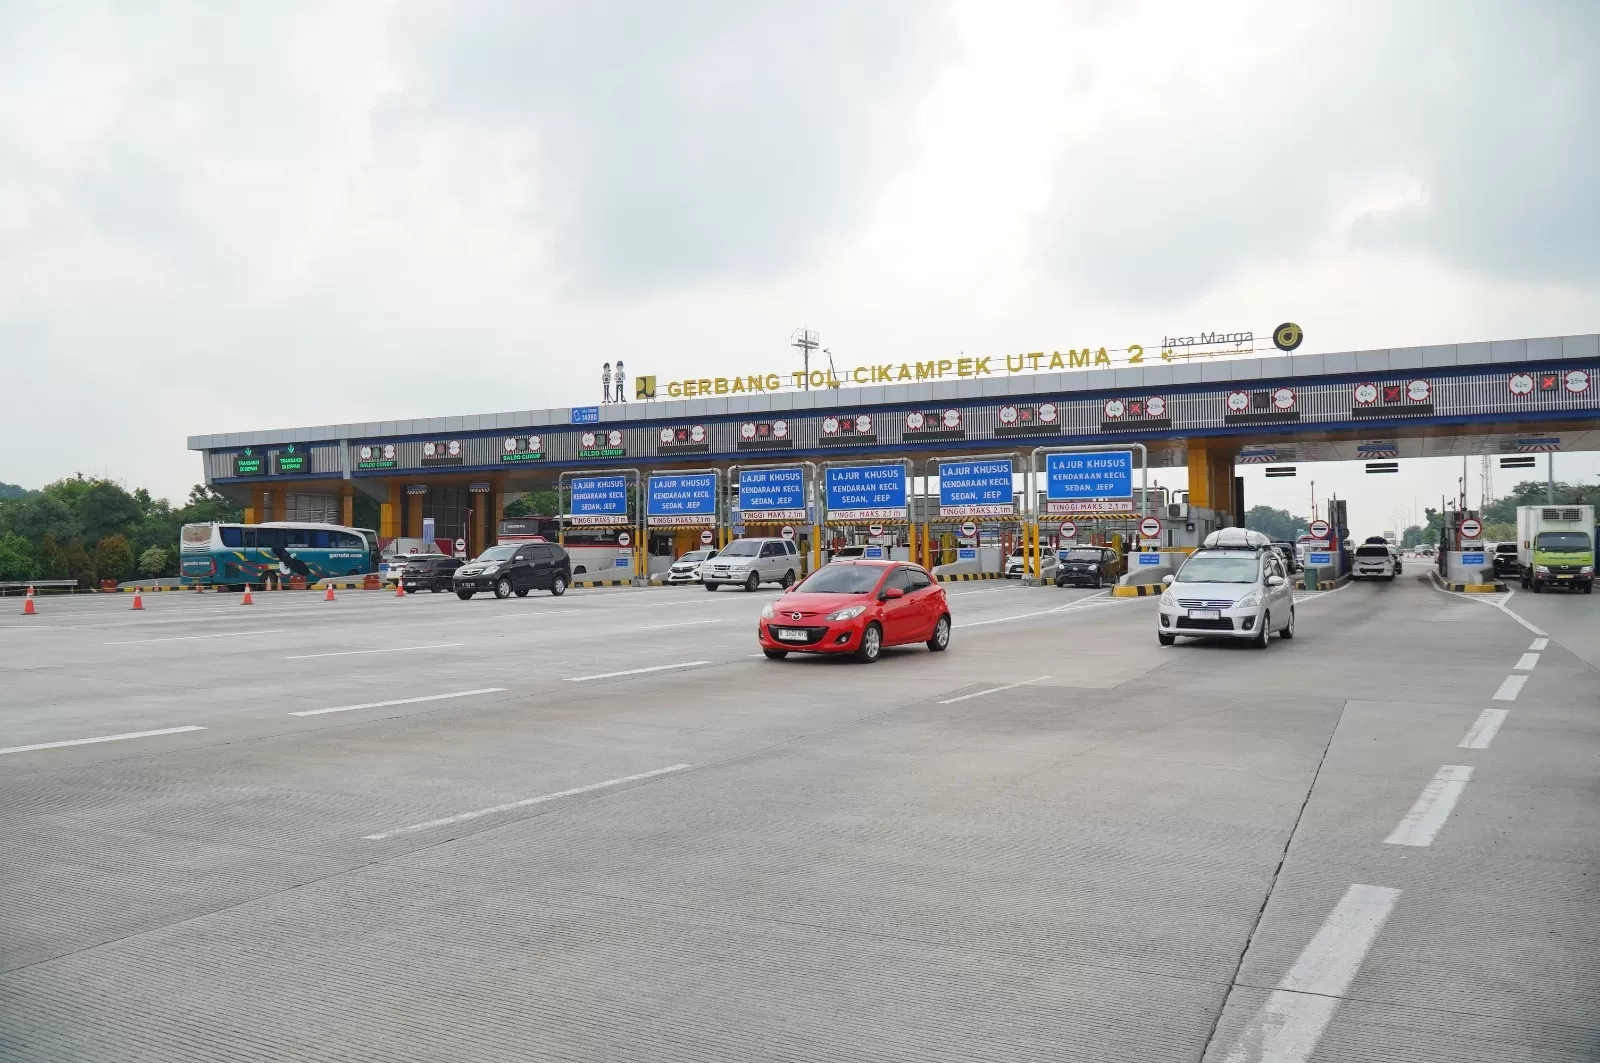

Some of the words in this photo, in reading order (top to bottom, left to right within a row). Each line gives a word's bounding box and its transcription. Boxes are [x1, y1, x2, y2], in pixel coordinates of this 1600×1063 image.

[1164, 335, 1194, 347] Jasa
[1201, 331, 1253, 346] Marga
[667, 373, 780, 397] GERBANG
[792, 369, 839, 389] TOL
[853, 356, 992, 384] CIKAMPEK
[1006, 346, 1111, 373] UTAMA
[1127, 344, 1144, 363] 2
[1053, 460, 1083, 470] LAJUR
[1087, 459, 1126, 468] KHUSUS
[942, 466, 971, 476] LAJUR
[973, 464, 1009, 474] KHUSUS
[769, 473, 800, 481] KHUSUS
[832, 472, 860, 481] LAJUR
[864, 470, 898, 479] KHUSUS
[1053, 473, 1102, 481] KENDARAAN
[574, 481, 595, 490] LAJUR
[597, 480, 624, 488] KHUSUS
[654, 481, 677, 489] LAJUR
[680, 479, 710, 487] KHUSUS
[832, 483, 876, 493] KENDARAAN
[879, 483, 898, 491] KECIL
[942, 479, 988, 488] KENDARAAN
[989, 478, 1010, 487] KECIL
[1065, 484, 1093, 492] SEDAN,
[1096, 483, 1114, 491] JEEP
[741, 486, 781, 494] KENDARAAN
[783, 485, 800, 493] KECIL
[573, 492, 607, 500] KENDARAAN
[609, 491, 624, 499] KECIL
[653, 491, 691, 500] KENDARAAN
[693, 490, 710, 498] KECIL
[841, 495, 868, 504] SEDAN,
[872, 494, 891, 502] JEEP
[951, 492, 978, 500] SEDAN,
[982, 490, 1001, 499] JEEP
[662, 502, 684, 510] SEDAN,
[686, 501, 700, 509] JEEP
[776, 497, 792, 505] JEEP
[581, 502, 602, 511] SEDAN,
[602, 502, 616, 510] JEEP
[573, 516, 593, 524] TINGGI
